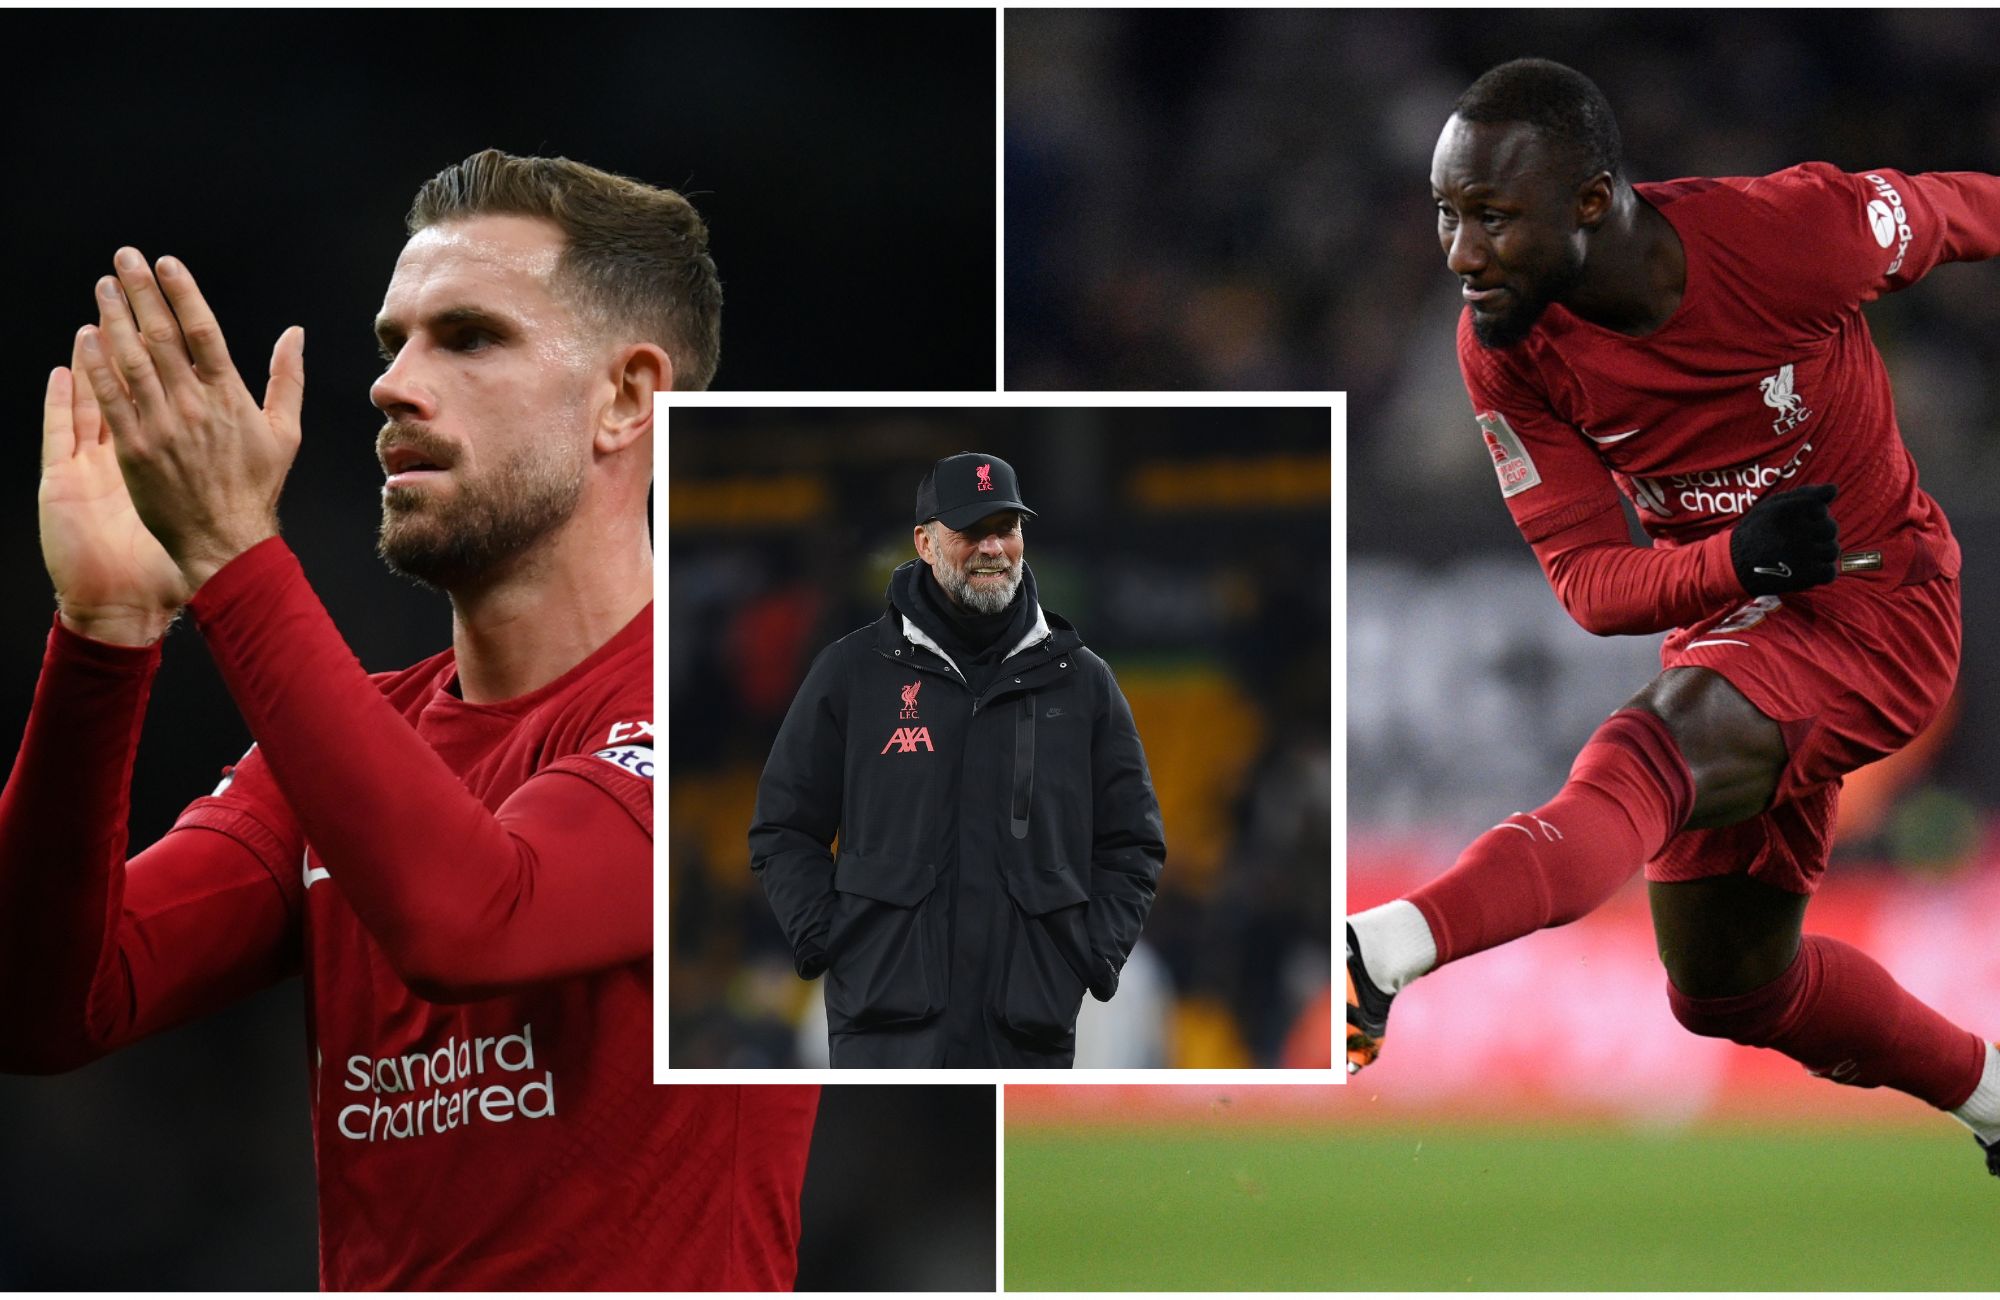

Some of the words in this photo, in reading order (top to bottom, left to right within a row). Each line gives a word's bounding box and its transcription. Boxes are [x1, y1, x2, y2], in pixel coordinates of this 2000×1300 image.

[1680, 488, 1758, 514] chart
[880, 726, 935, 755] AXA
[337, 1071, 555, 1142] chartered
